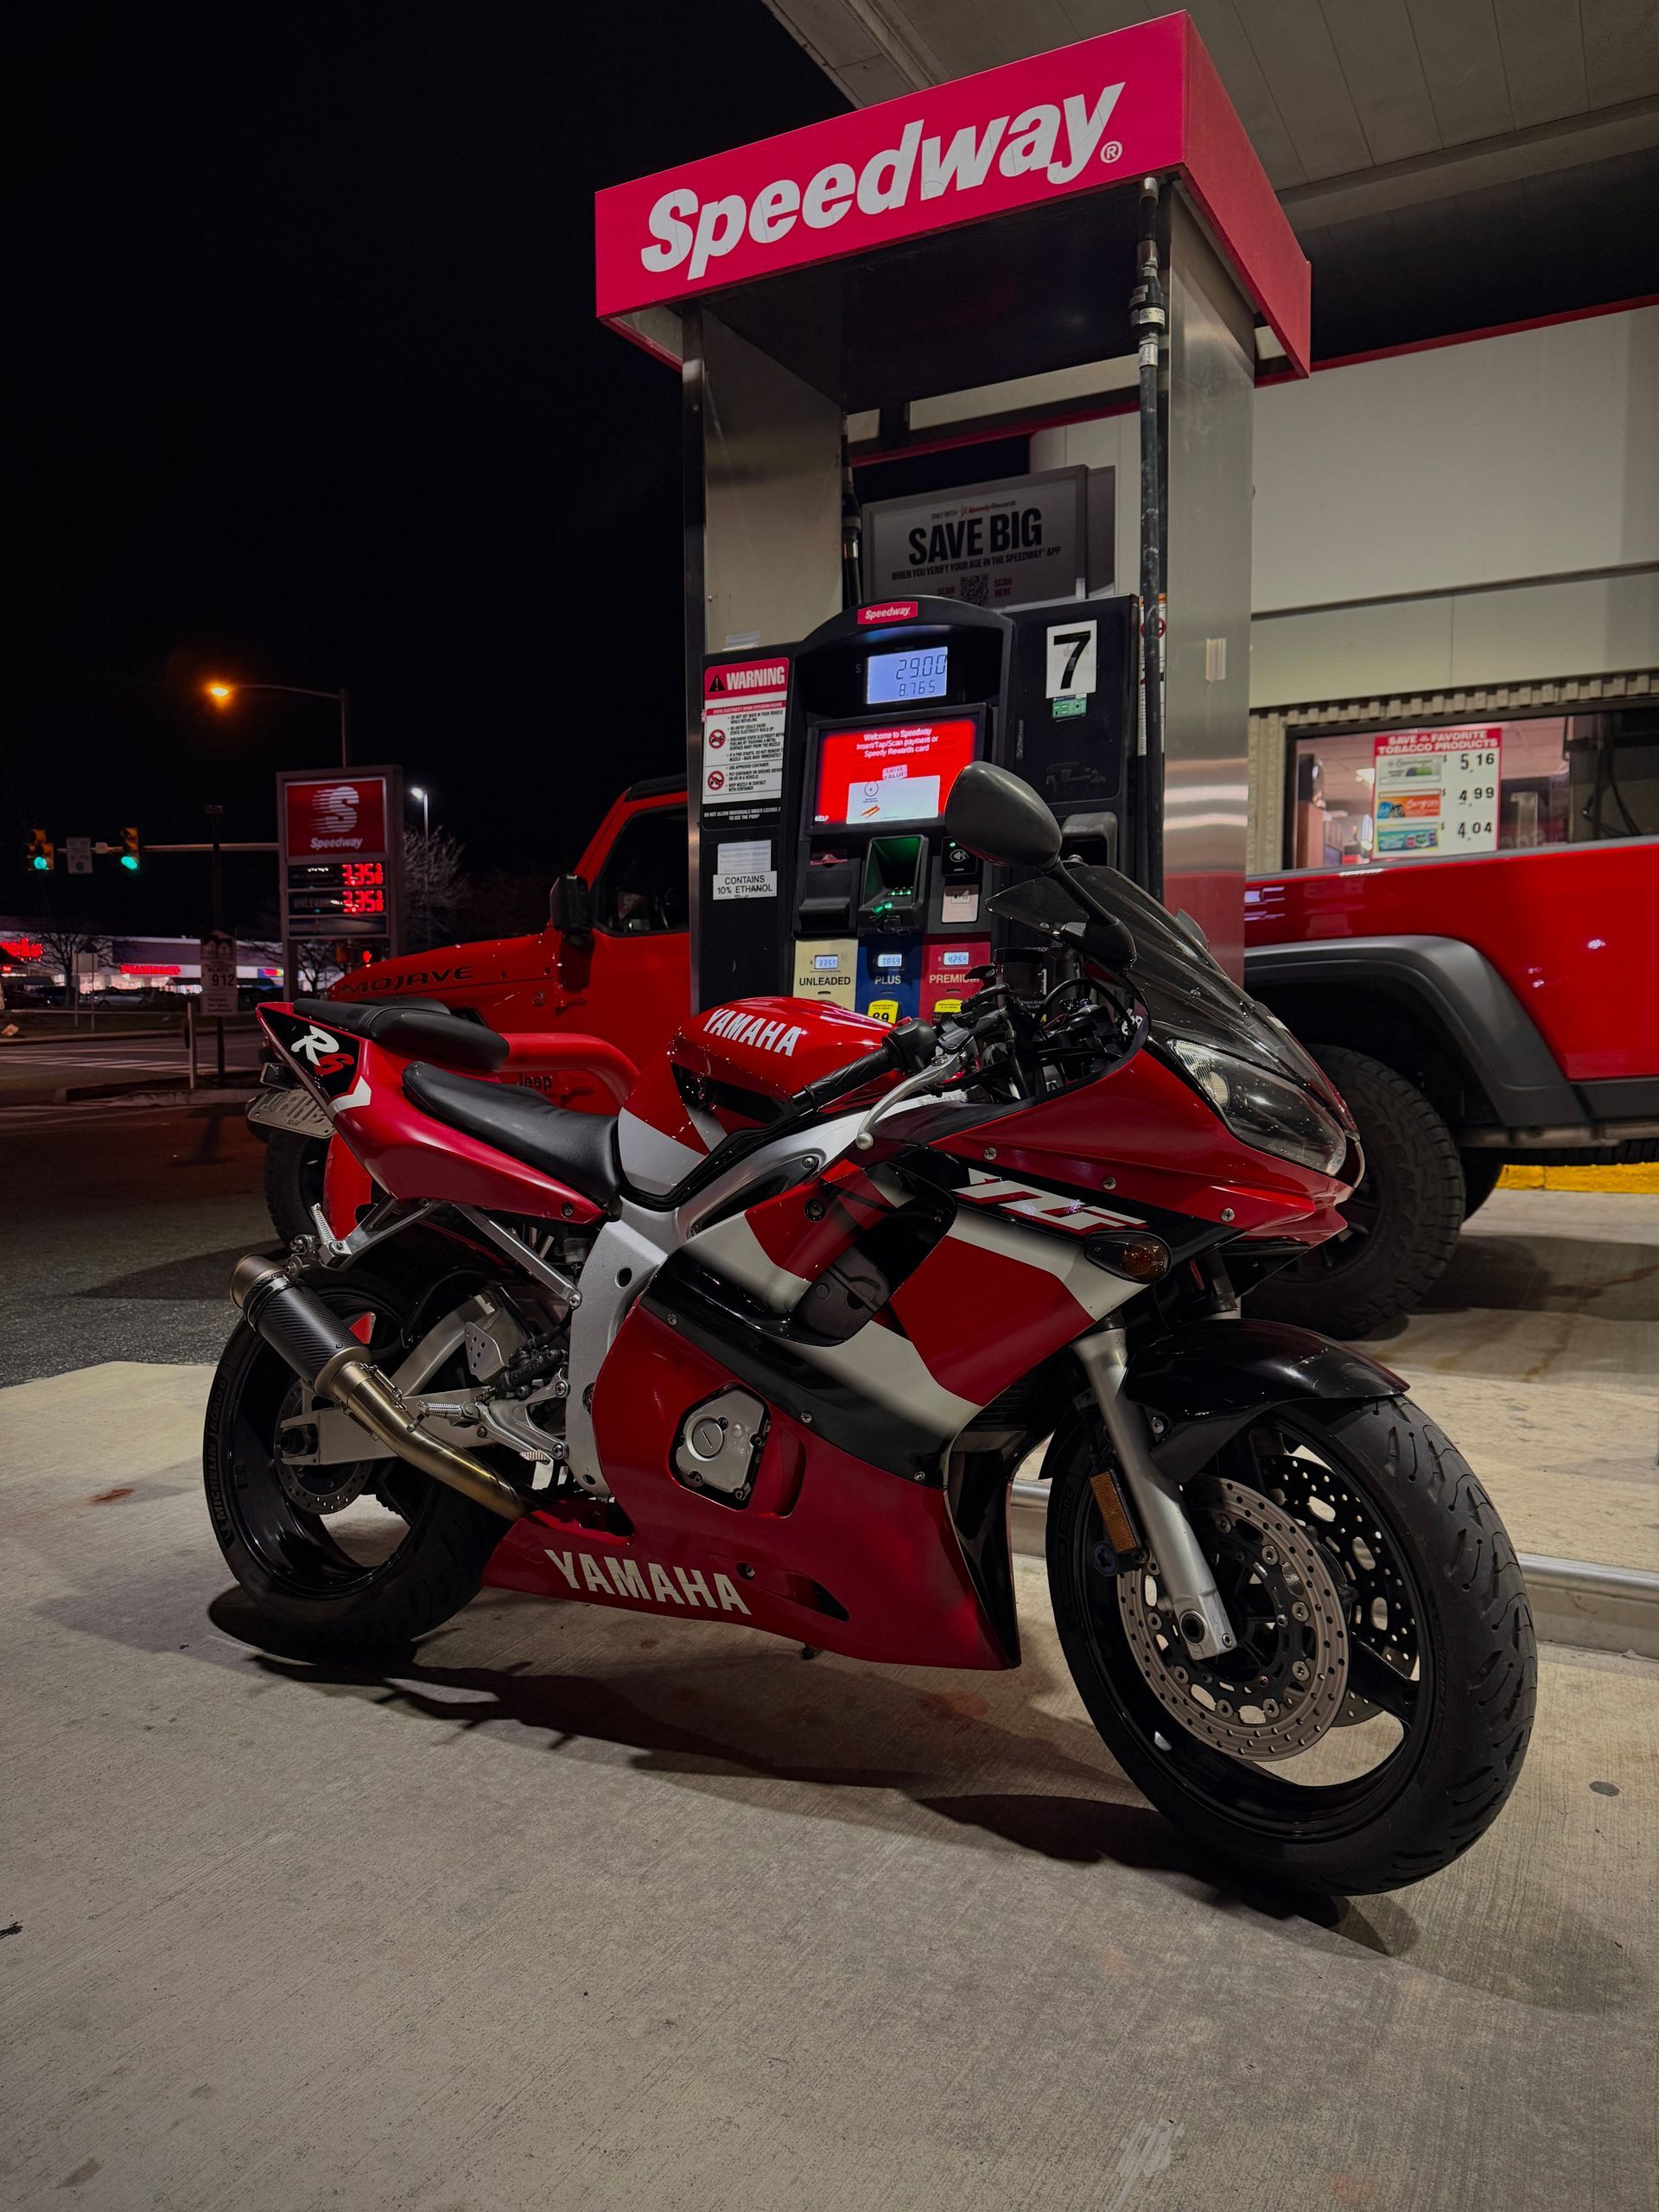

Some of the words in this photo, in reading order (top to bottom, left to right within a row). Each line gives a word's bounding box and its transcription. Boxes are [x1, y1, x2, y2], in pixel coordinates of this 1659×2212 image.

[909, 518, 983, 565] SAVE
[990, 507, 1042, 553] BIG
[892, 571, 912, 581] WHEN
[912, 568, 925, 577] YOU
[926, 564, 950, 575] VERIFY
[950, 562, 968, 572] YOUR
[969, 559, 982, 569] AGE
[983, 558, 990, 567] IN
[992, 556, 1004, 565] THE
[1046, 546, 1061, 556] APP
[995, 577, 1012, 587] SCAN
[865, 607, 911, 620] Speedway
[896, 654, 947, 679] 29.00
[1054, 631, 1091, 690] 7
[726, 666, 785, 690] WARNING
[899, 680, 935, 696] 8.765
[863, 730, 892, 741] Welcome
[900, 728, 931, 739] Speedway
[1388, 735, 1417, 745] SAVE
[1431, 730, 1487, 741] FAVORITE
[857, 740, 904, 750] Insert/Tap/Scan
[904, 737, 930, 746] payment
[1378, 742, 1433, 754] TOBACCO
[1434, 738, 1497, 752] PRODUCTS
[864, 749, 887, 759] Speedy
[888, 746, 915, 755] Rewards
[1460, 753, 1495, 772] 5.16
[1459, 787, 1494, 807] 4.99
[1459, 823, 1492, 841] 4.04
[310, 836, 363, 851] Speedway
[725, 875, 765, 885] CONTAINS
[735, 885, 772, 893] ETHANOL
[340, 965, 474, 995] MOJAVE
[799, 976, 851, 986] UNLEADED
[874, 975, 901, 984] PLUS
[702, 1008, 803, 1057] YAMAHA
[543, 1548, 752, 1615] YAMAHA
